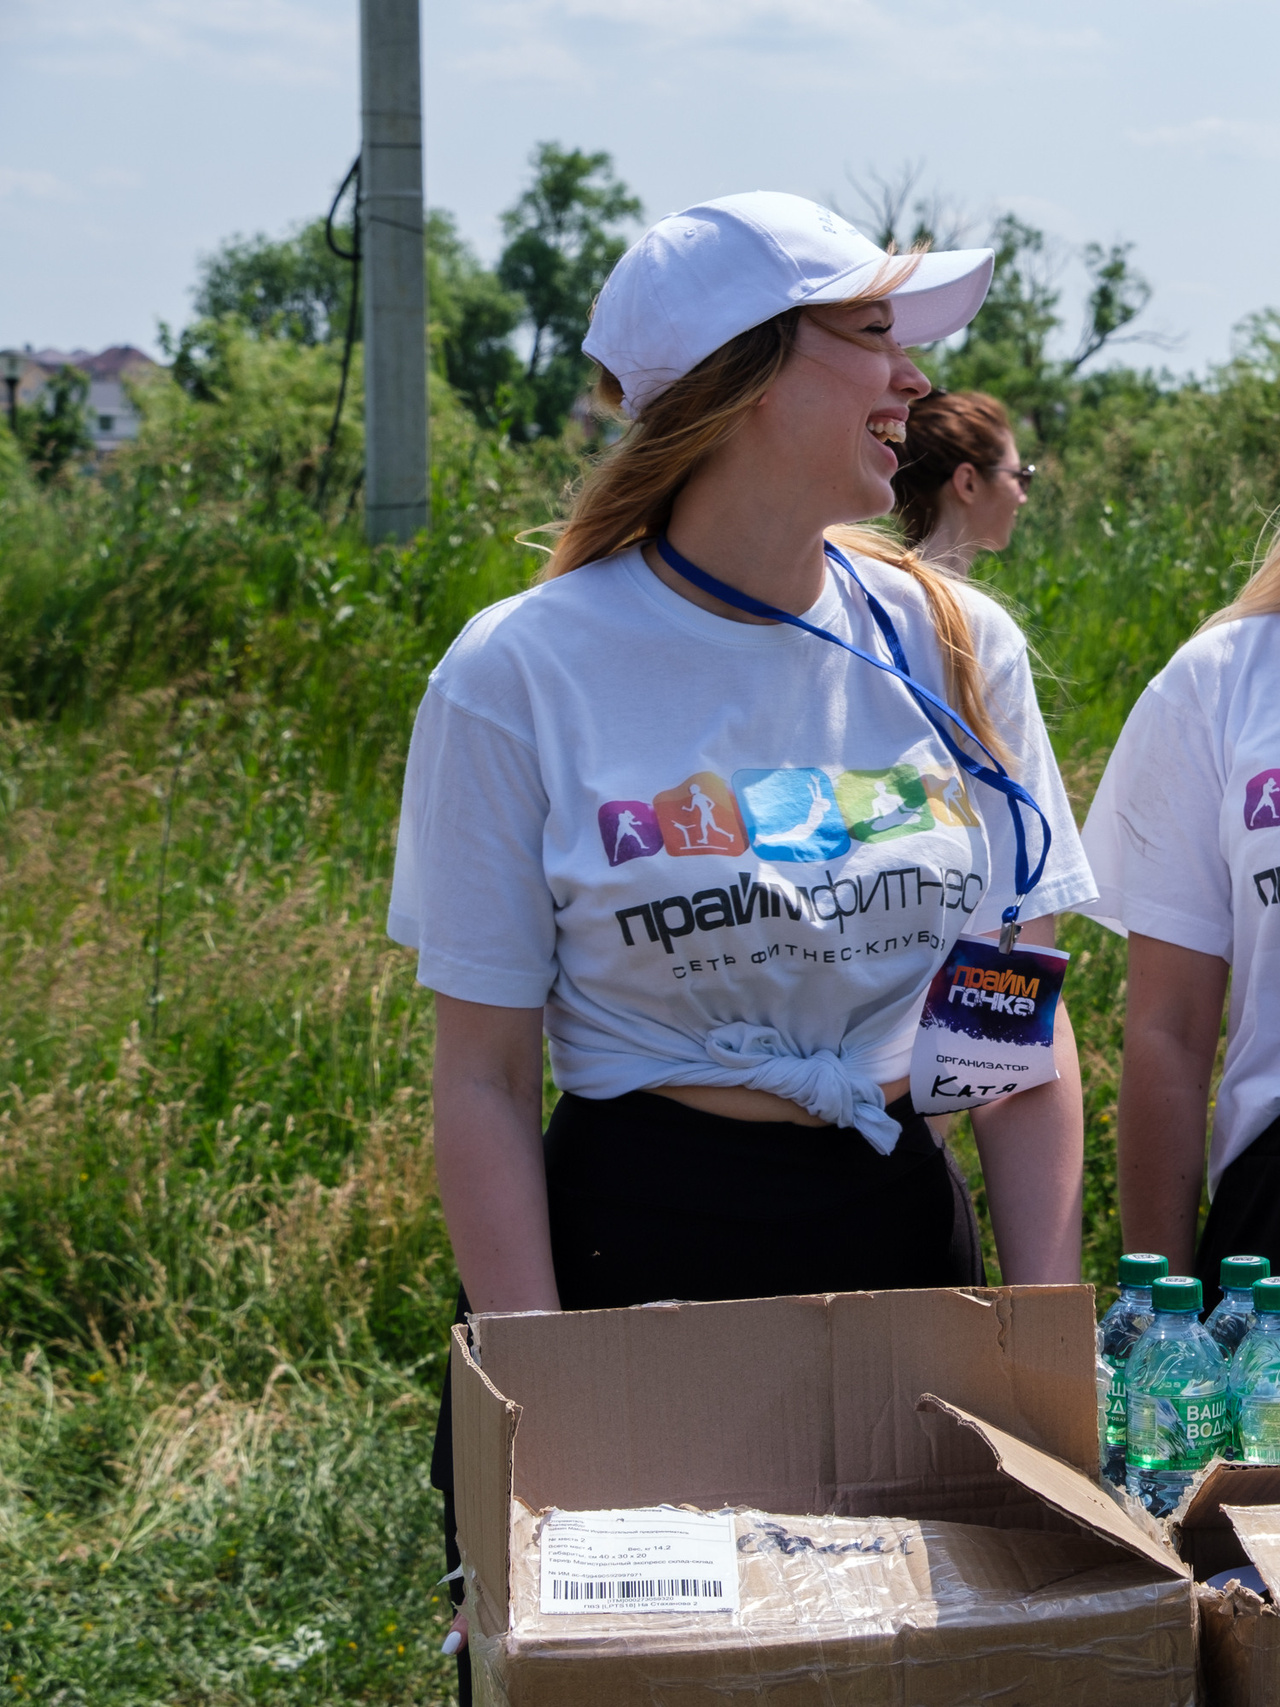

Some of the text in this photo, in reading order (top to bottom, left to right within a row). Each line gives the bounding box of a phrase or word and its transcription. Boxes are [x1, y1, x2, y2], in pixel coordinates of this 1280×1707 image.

[672, 954, 736, 979] СЕТЬ
[936, 1054, 1029, 1072] ОРГАНИЗАТОР
[573, 1559, 632, 1567] Магистральный
